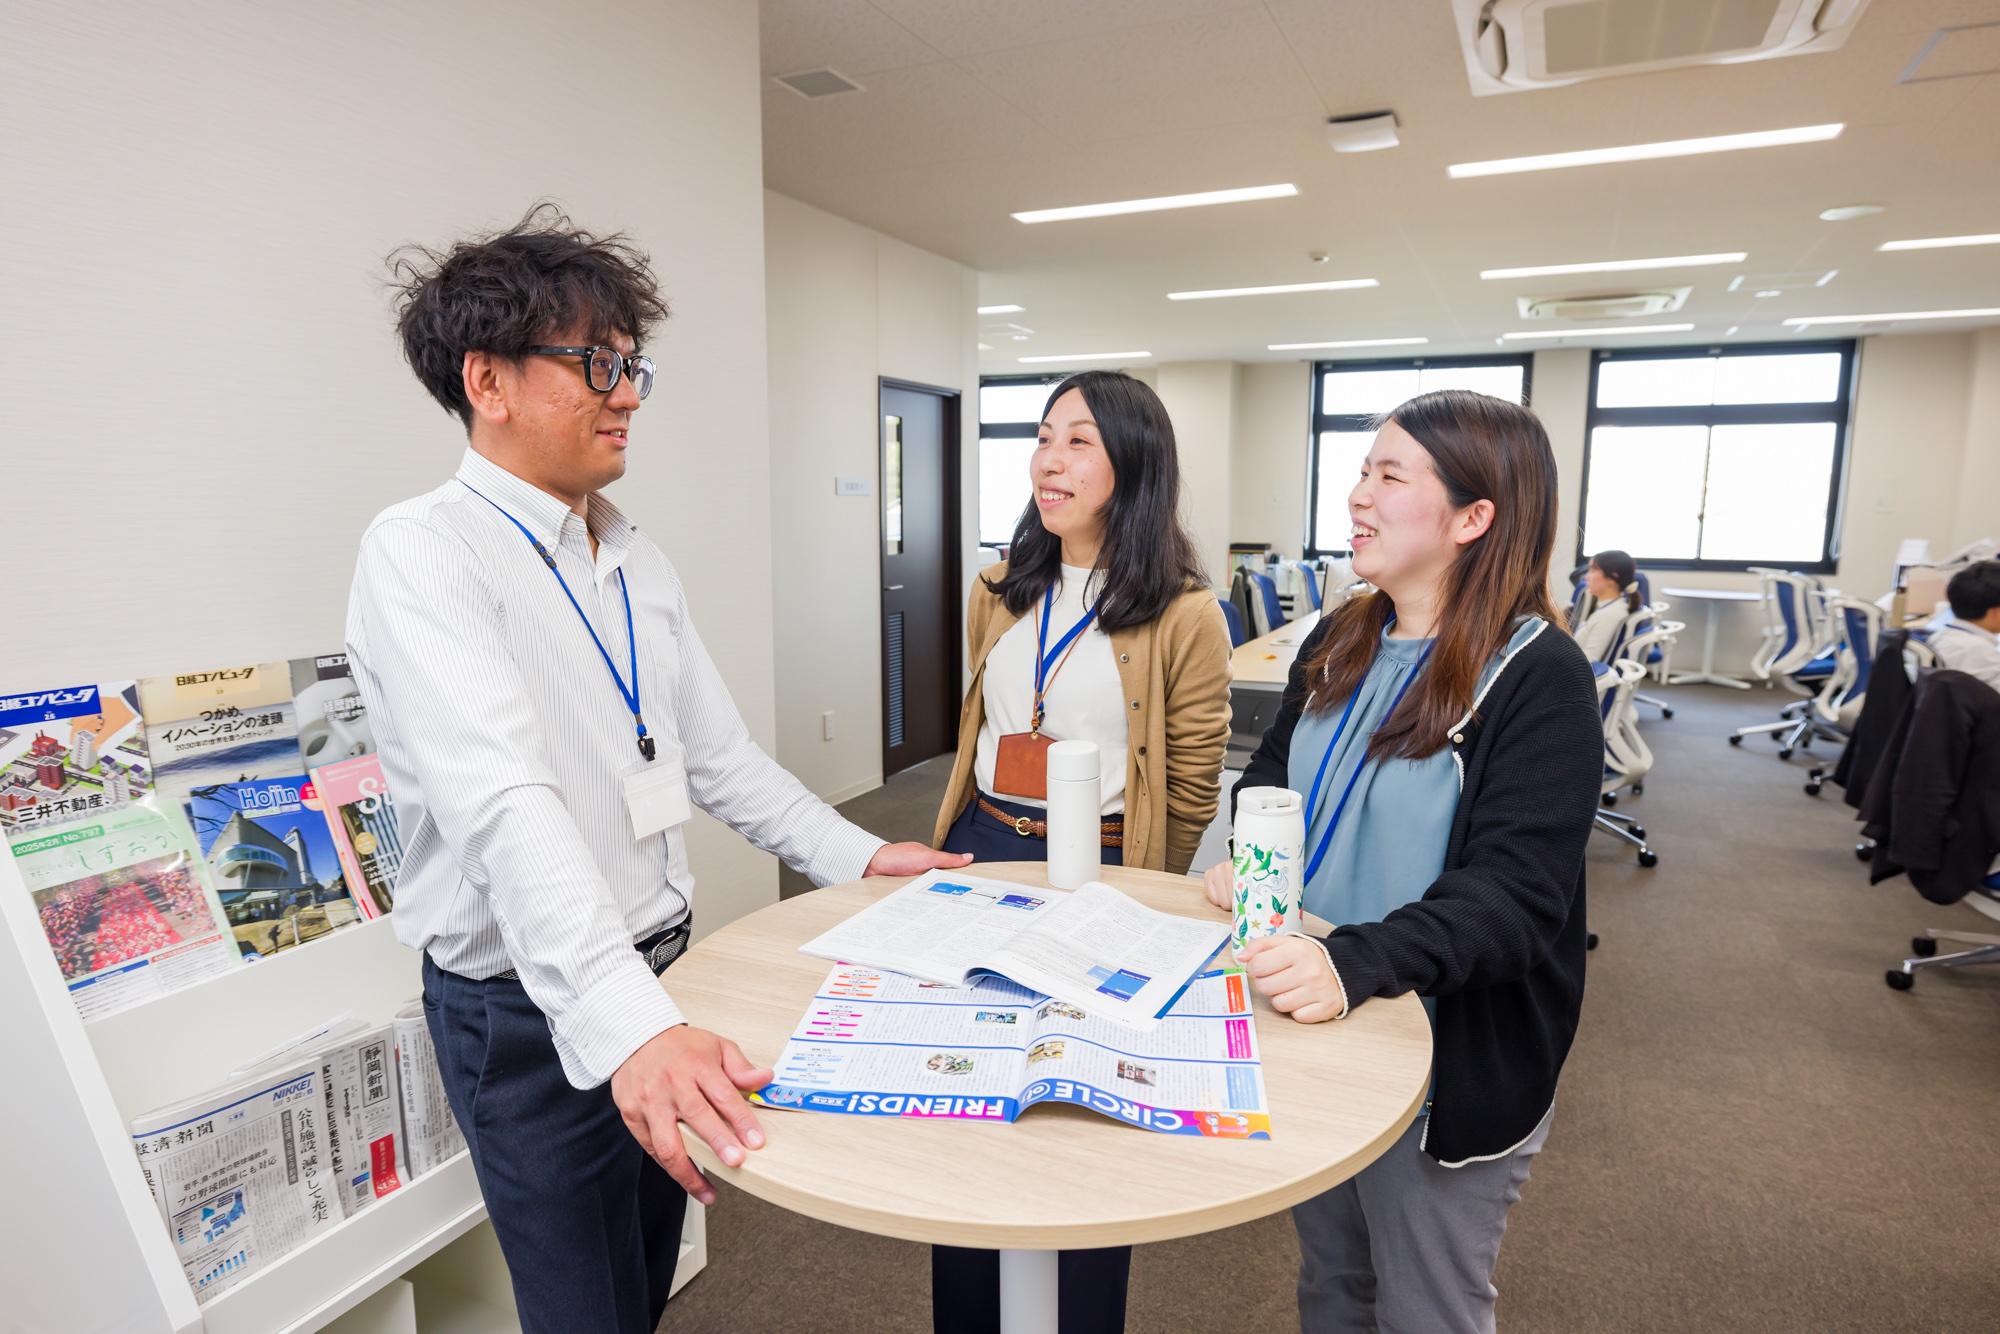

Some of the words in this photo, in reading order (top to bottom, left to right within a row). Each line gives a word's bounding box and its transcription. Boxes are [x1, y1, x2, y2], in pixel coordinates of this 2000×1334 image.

[176, 667, 254, 686] 日経コンピュータ
[200, 706, 244, 722] つかめ、
[162, 711, 283, 743] イノベーションの波頭
[18, 793, 110, 823] 三井不動産、
[238, 784, 300, 809] Hojin
[364, 1046, 384, 1101] 静岡新聞
[272, 1079, 311, 1101] NIKKEI
[846, 1094, 1005, 1117] FRIENDS!
[1055, 1081, 1183, 1130] CIRCLE
